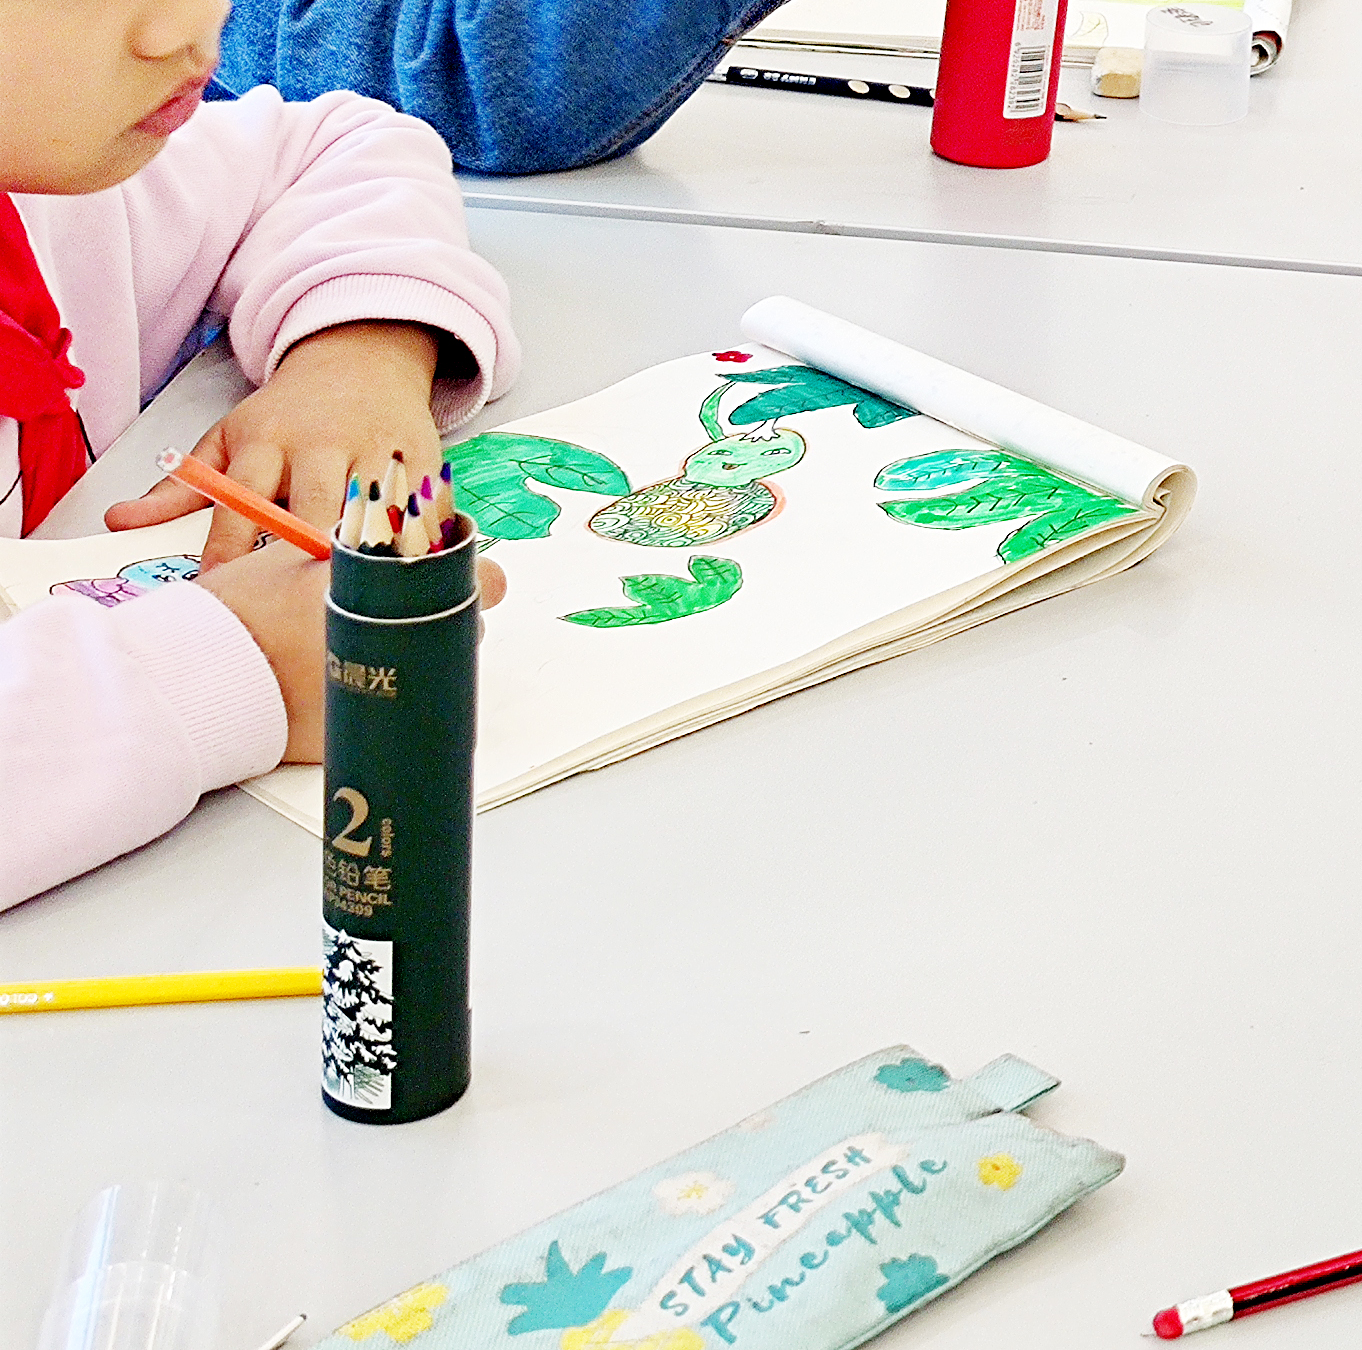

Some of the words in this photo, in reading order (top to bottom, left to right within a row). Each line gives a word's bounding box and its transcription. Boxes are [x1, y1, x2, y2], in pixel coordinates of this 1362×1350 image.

[339, 885, 393, 906] PENCIL
[659, 1233, 756, 1317] STAY
[756, 1145, 873, 1230] FRESH
[700, 1158, 949, 1345] Pineapple
